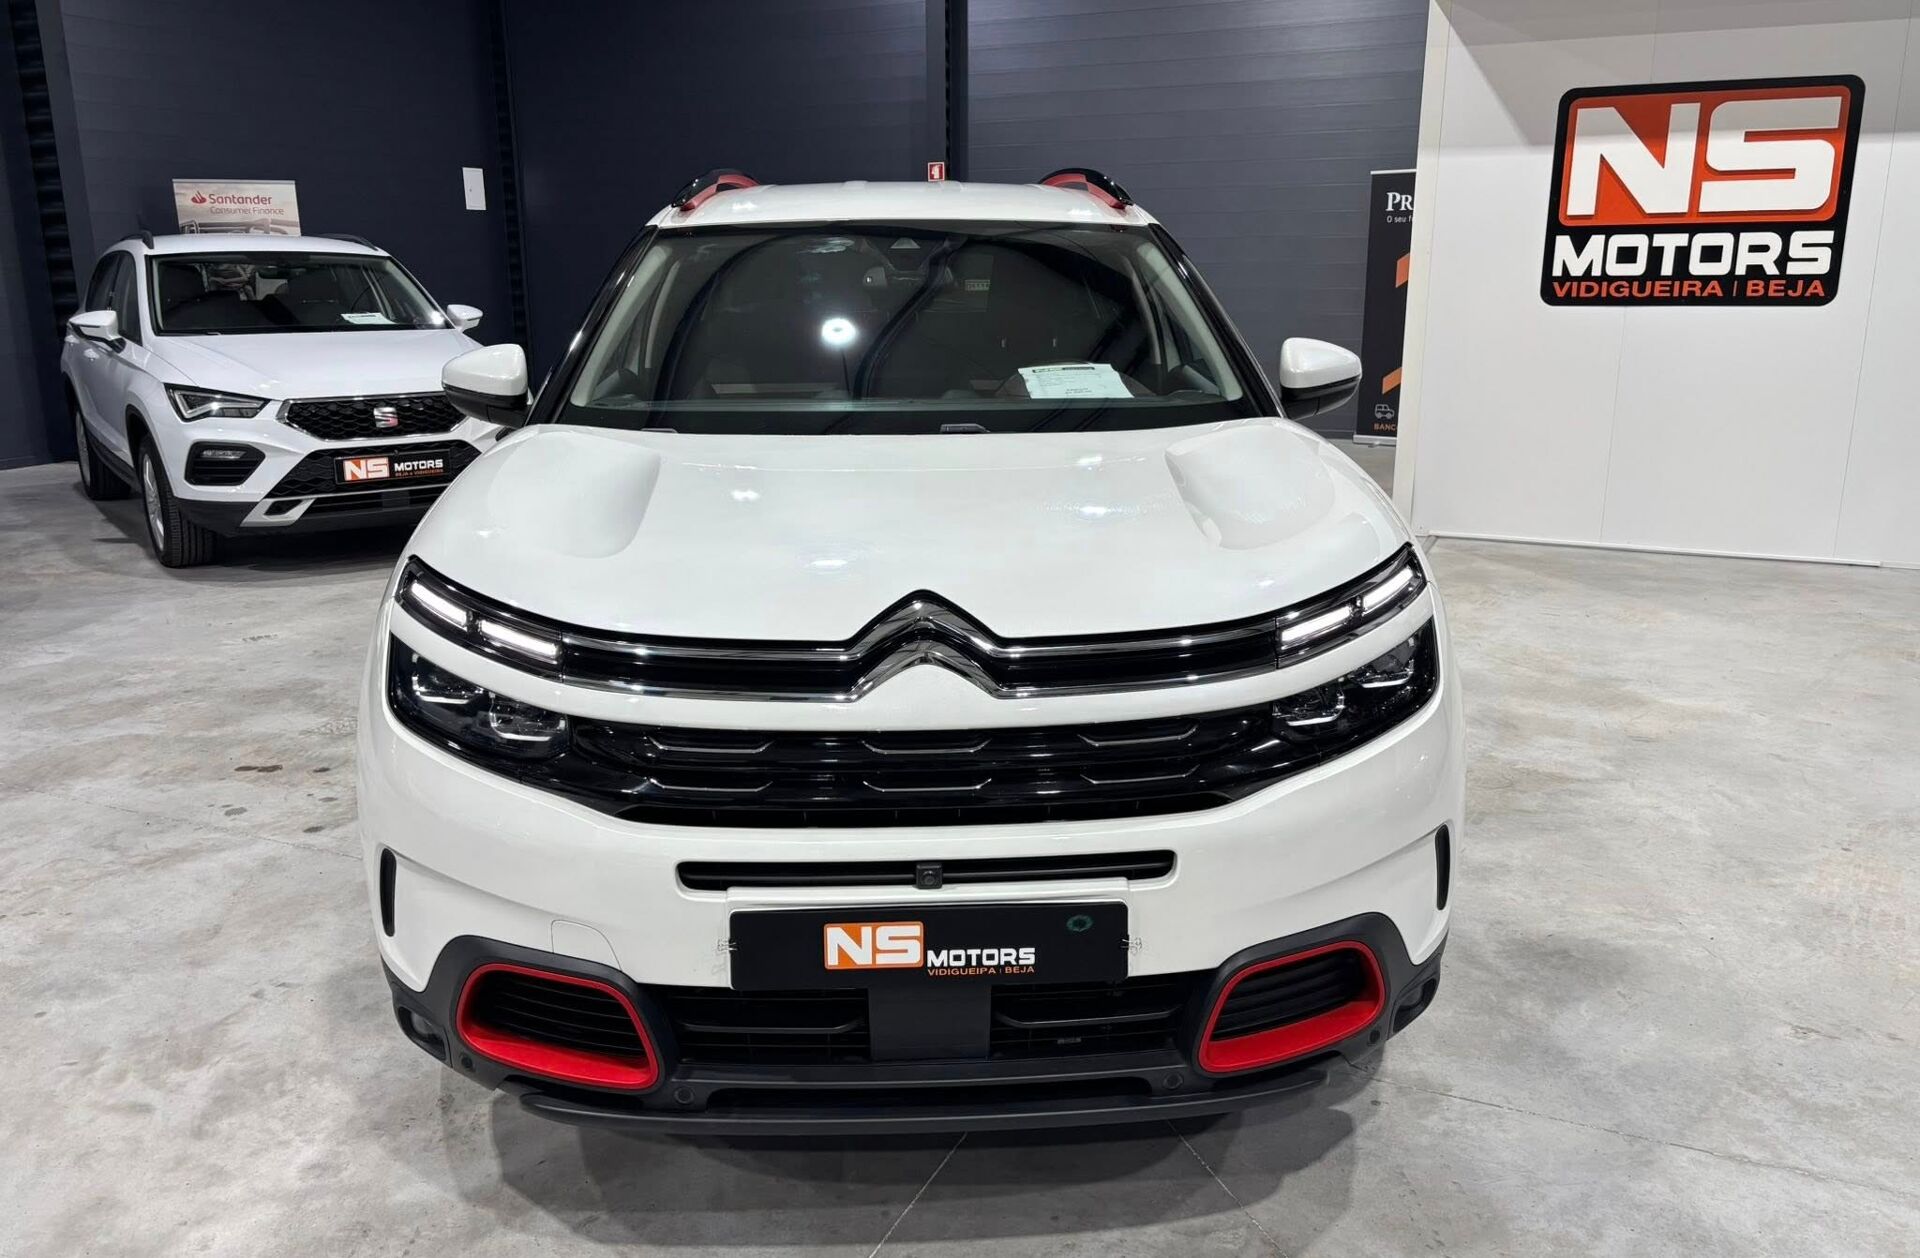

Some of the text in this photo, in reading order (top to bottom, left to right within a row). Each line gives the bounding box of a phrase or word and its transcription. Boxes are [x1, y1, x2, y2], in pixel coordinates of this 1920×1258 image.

[1566, 96, 1842, 216] NS
[208, 193, 272, 205] Santander
[210, 206, 284, 215] Consumer Finance
[1552, 230, 1834, 277] MOTORS
[1552, 280, 1723, 298] VIDIGUEIRA
[1746, 279, 1825, 297] BEJA
[343, 457, 443, 481] NS MOTORS
[827, 925, 1036, 967] NS MOTORS
[1005, 965, 1035, 974] BEJA
